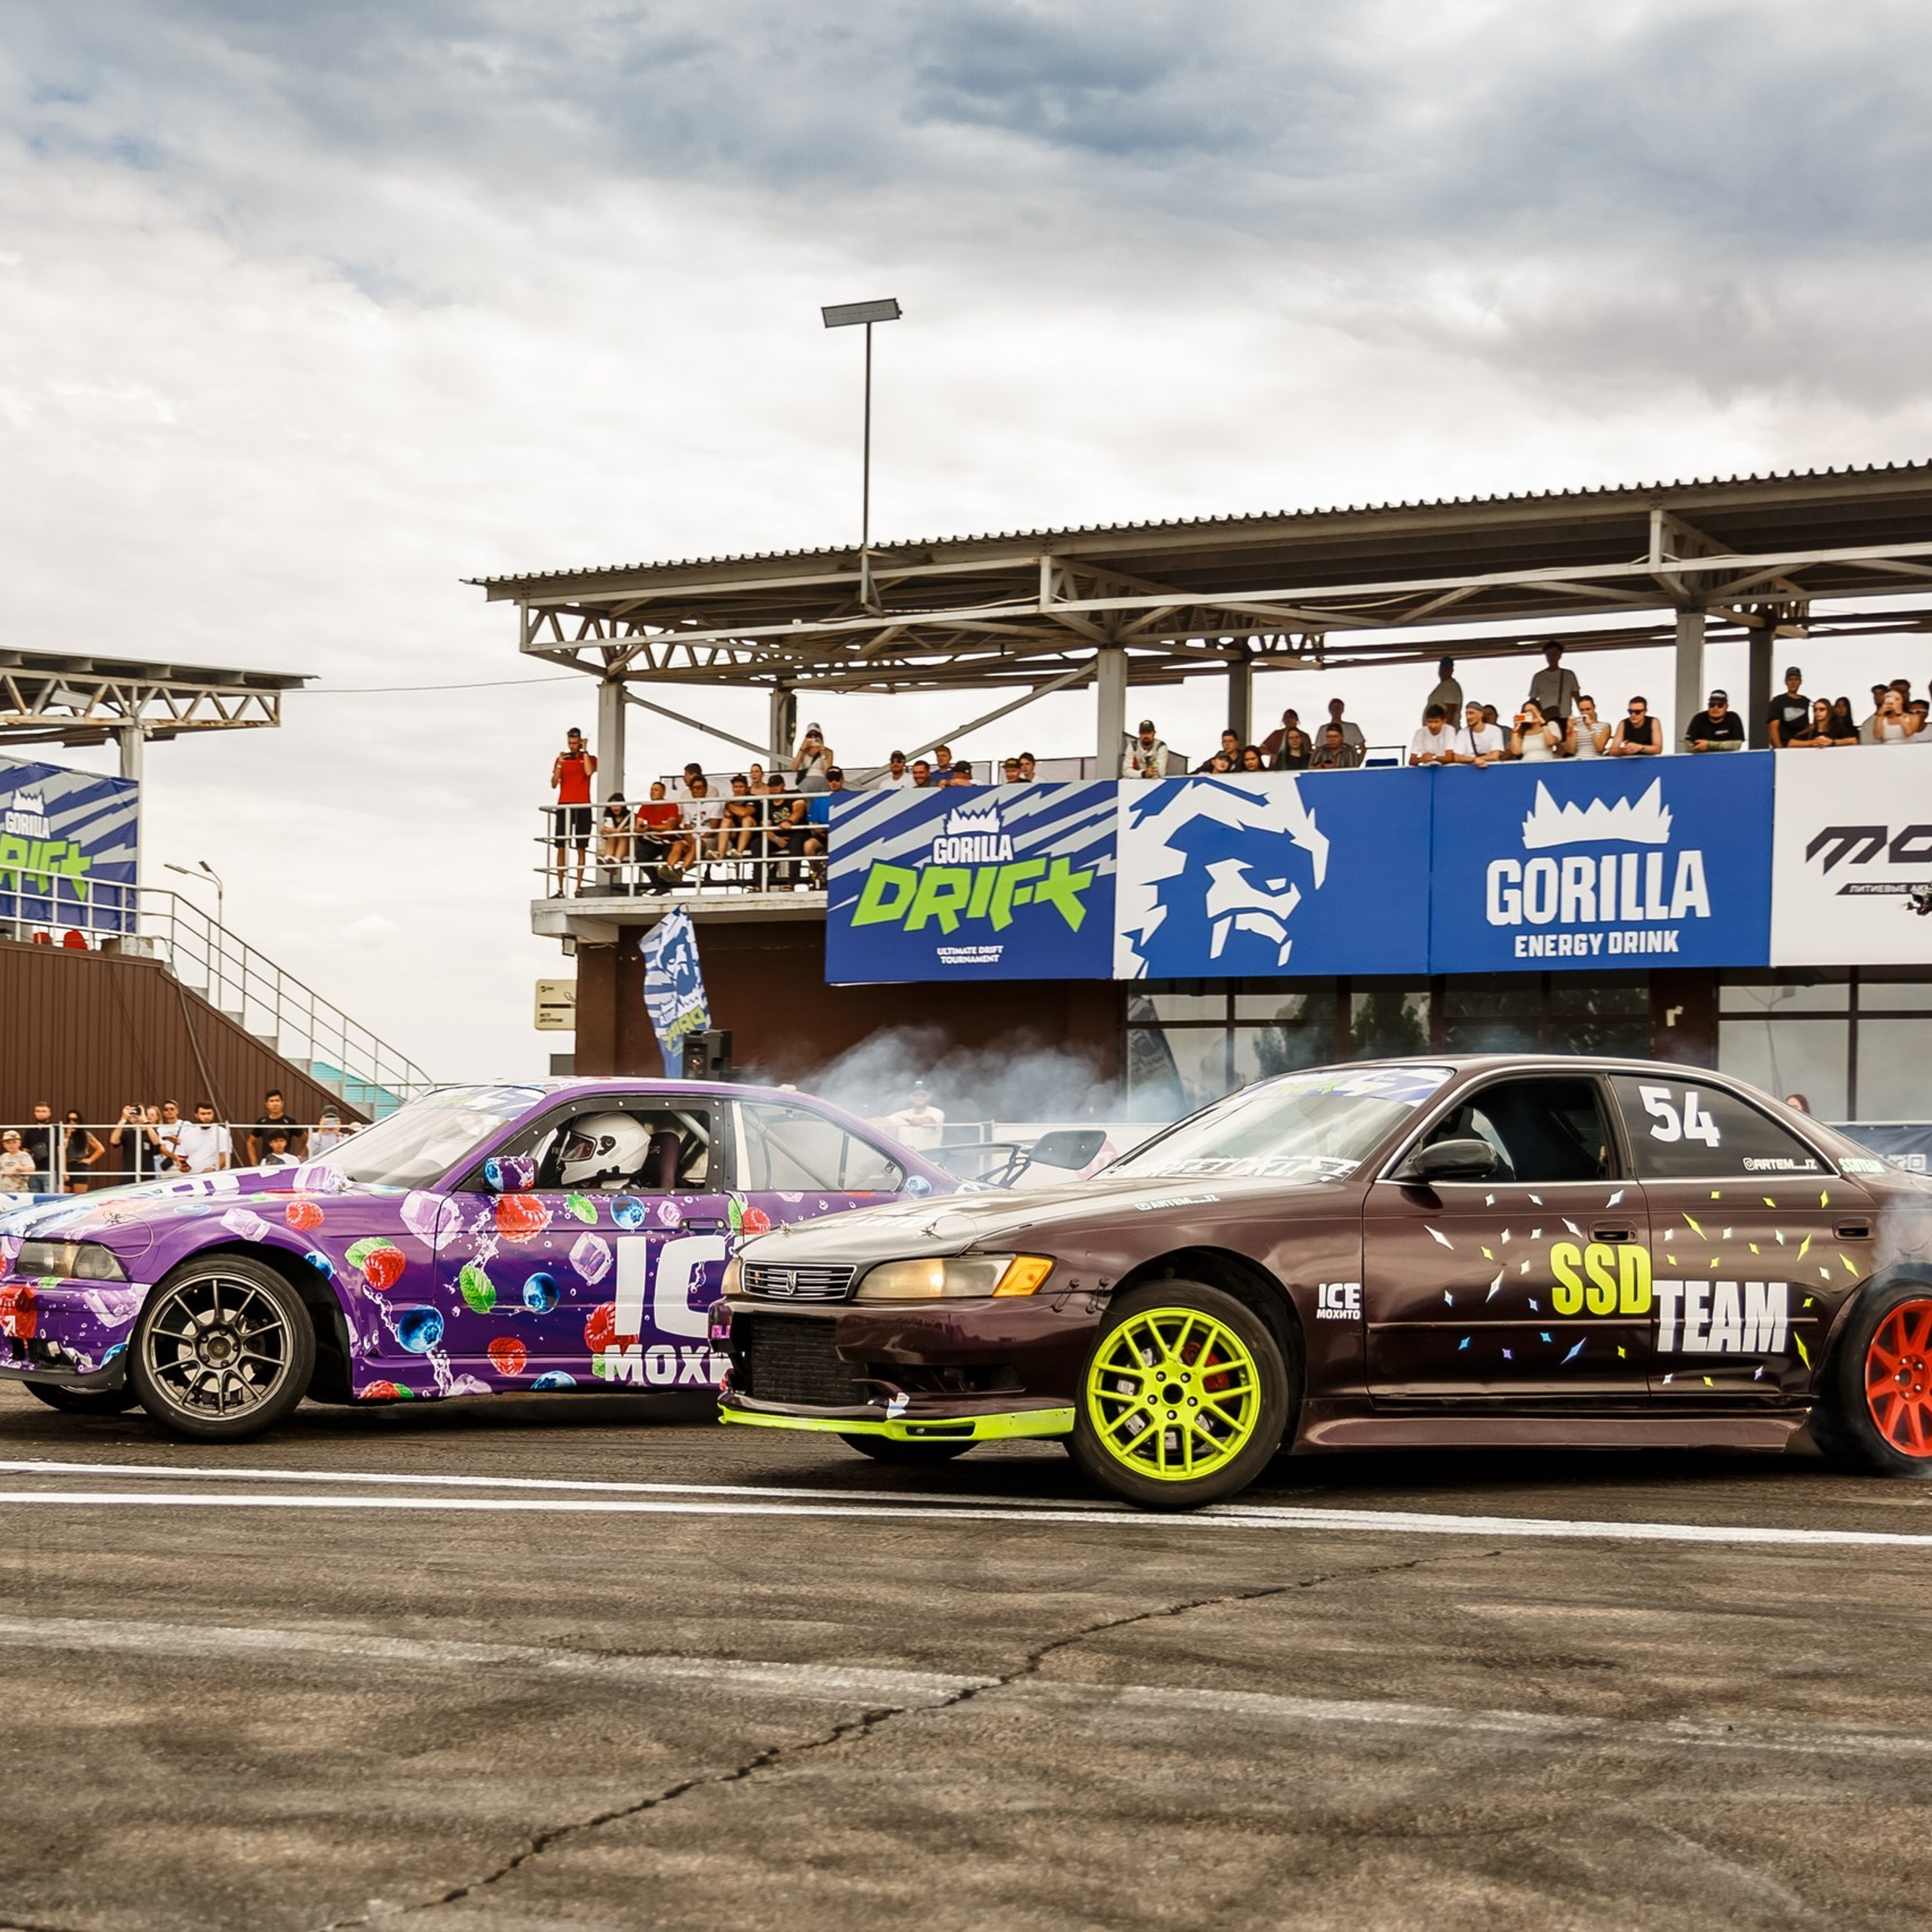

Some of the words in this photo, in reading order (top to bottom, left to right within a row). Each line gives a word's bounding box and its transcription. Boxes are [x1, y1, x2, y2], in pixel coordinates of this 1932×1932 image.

[5, 811, 51, 839] GORILLA
[934, 835, 1013, 863] GORILLA
[850, 857, 1094, 935] DRIFT
[1486, 850, 1711, 925] GORILLA
[937, 946, 977, 955] ULTIMATE
[978, 945, 1004, 954] DRIFT
[1515, 933, 1604, 958] ENERGY
[1608, 930, 1679, 954] DRINK
[940, 954, 1000, 964] TOURNAMENT
[1638, 1085, 1721, 1147] 54
[614, 1235, 743, 1339] IC
[1318, 1283, 1361, 1309] ICE
[1549, 1242, 1652, 1315] SSD
[1652, 1281, 1788, 1352] TEAM
[1316, 1309, 1361, 1320] МОХИТО
